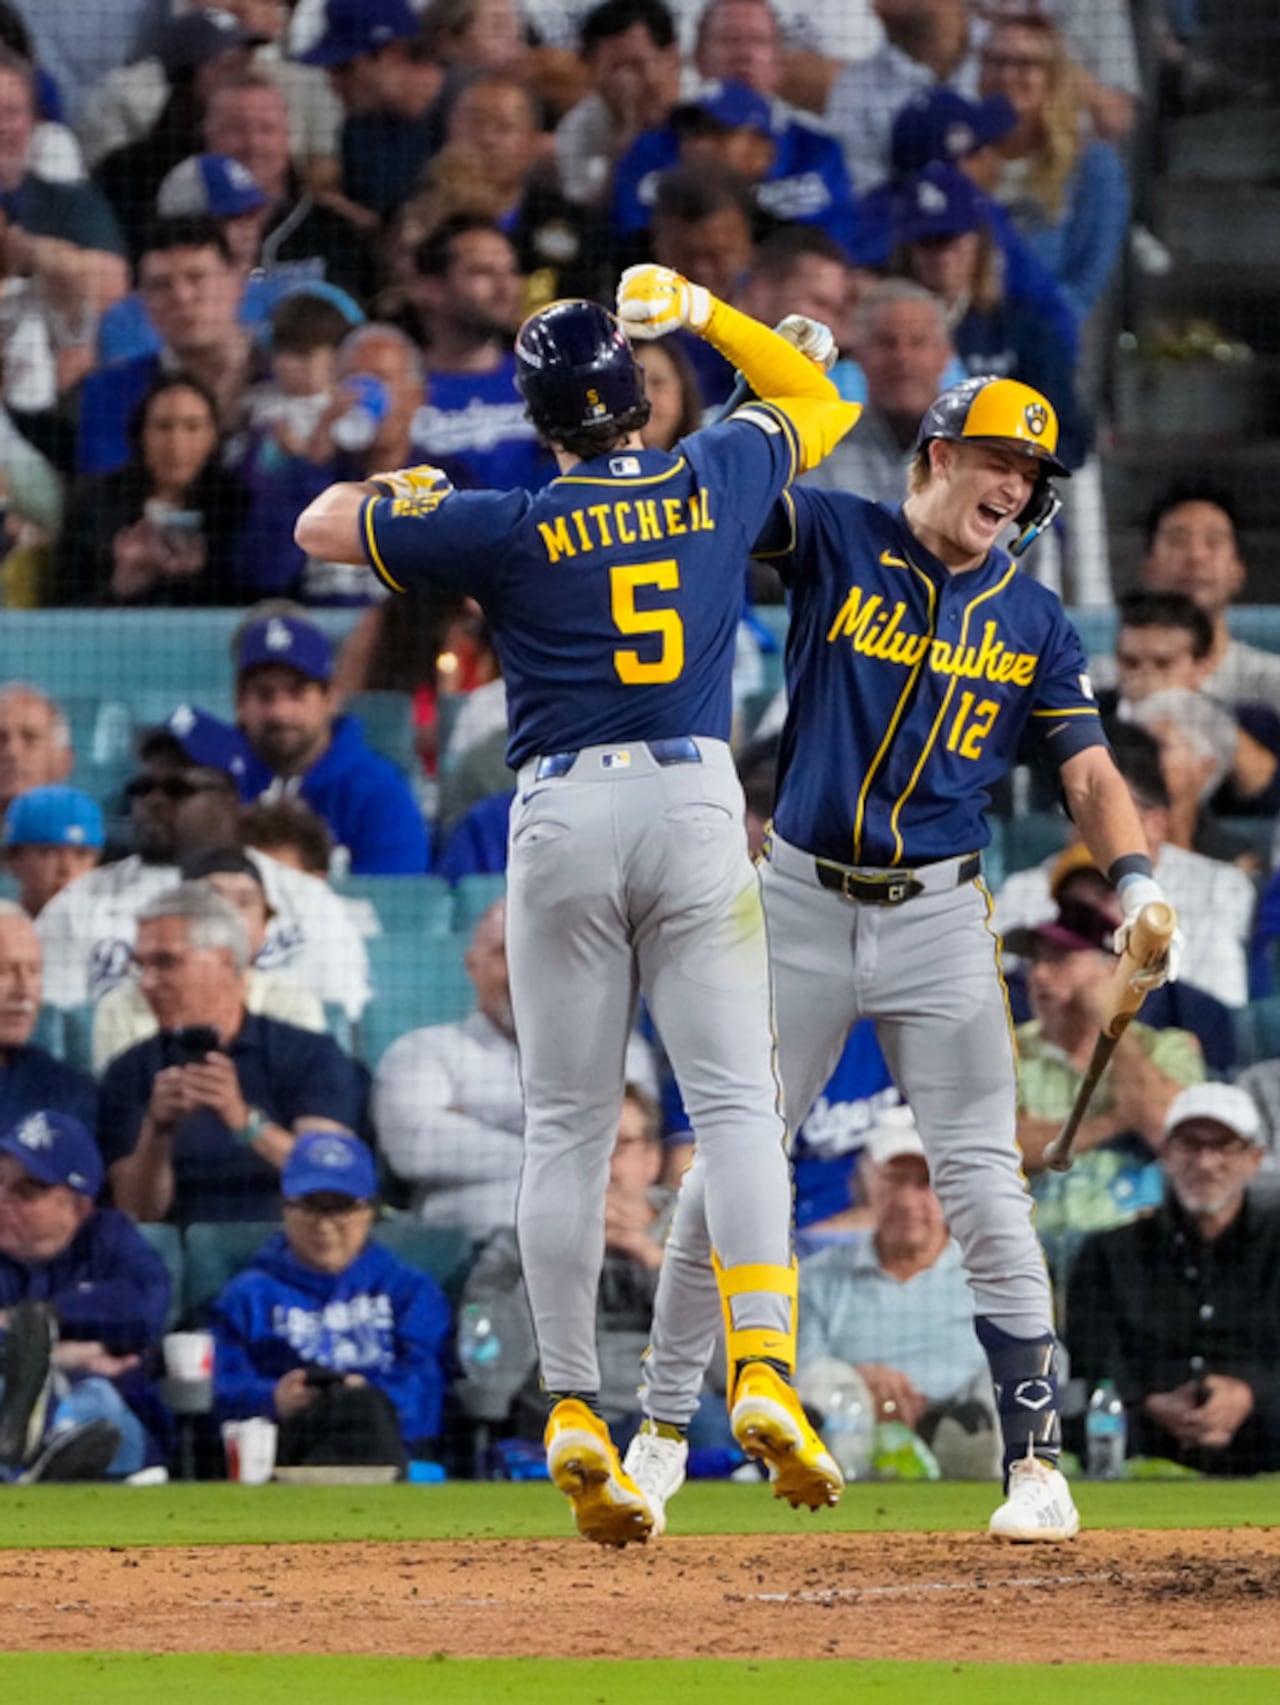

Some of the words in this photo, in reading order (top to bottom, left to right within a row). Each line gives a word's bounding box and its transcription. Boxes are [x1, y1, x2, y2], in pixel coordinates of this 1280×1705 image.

[609, 558, 687, 685] 5
[826, 585, 1039, 687] Milwaukee
[946, 690, 1001, 761] 12
